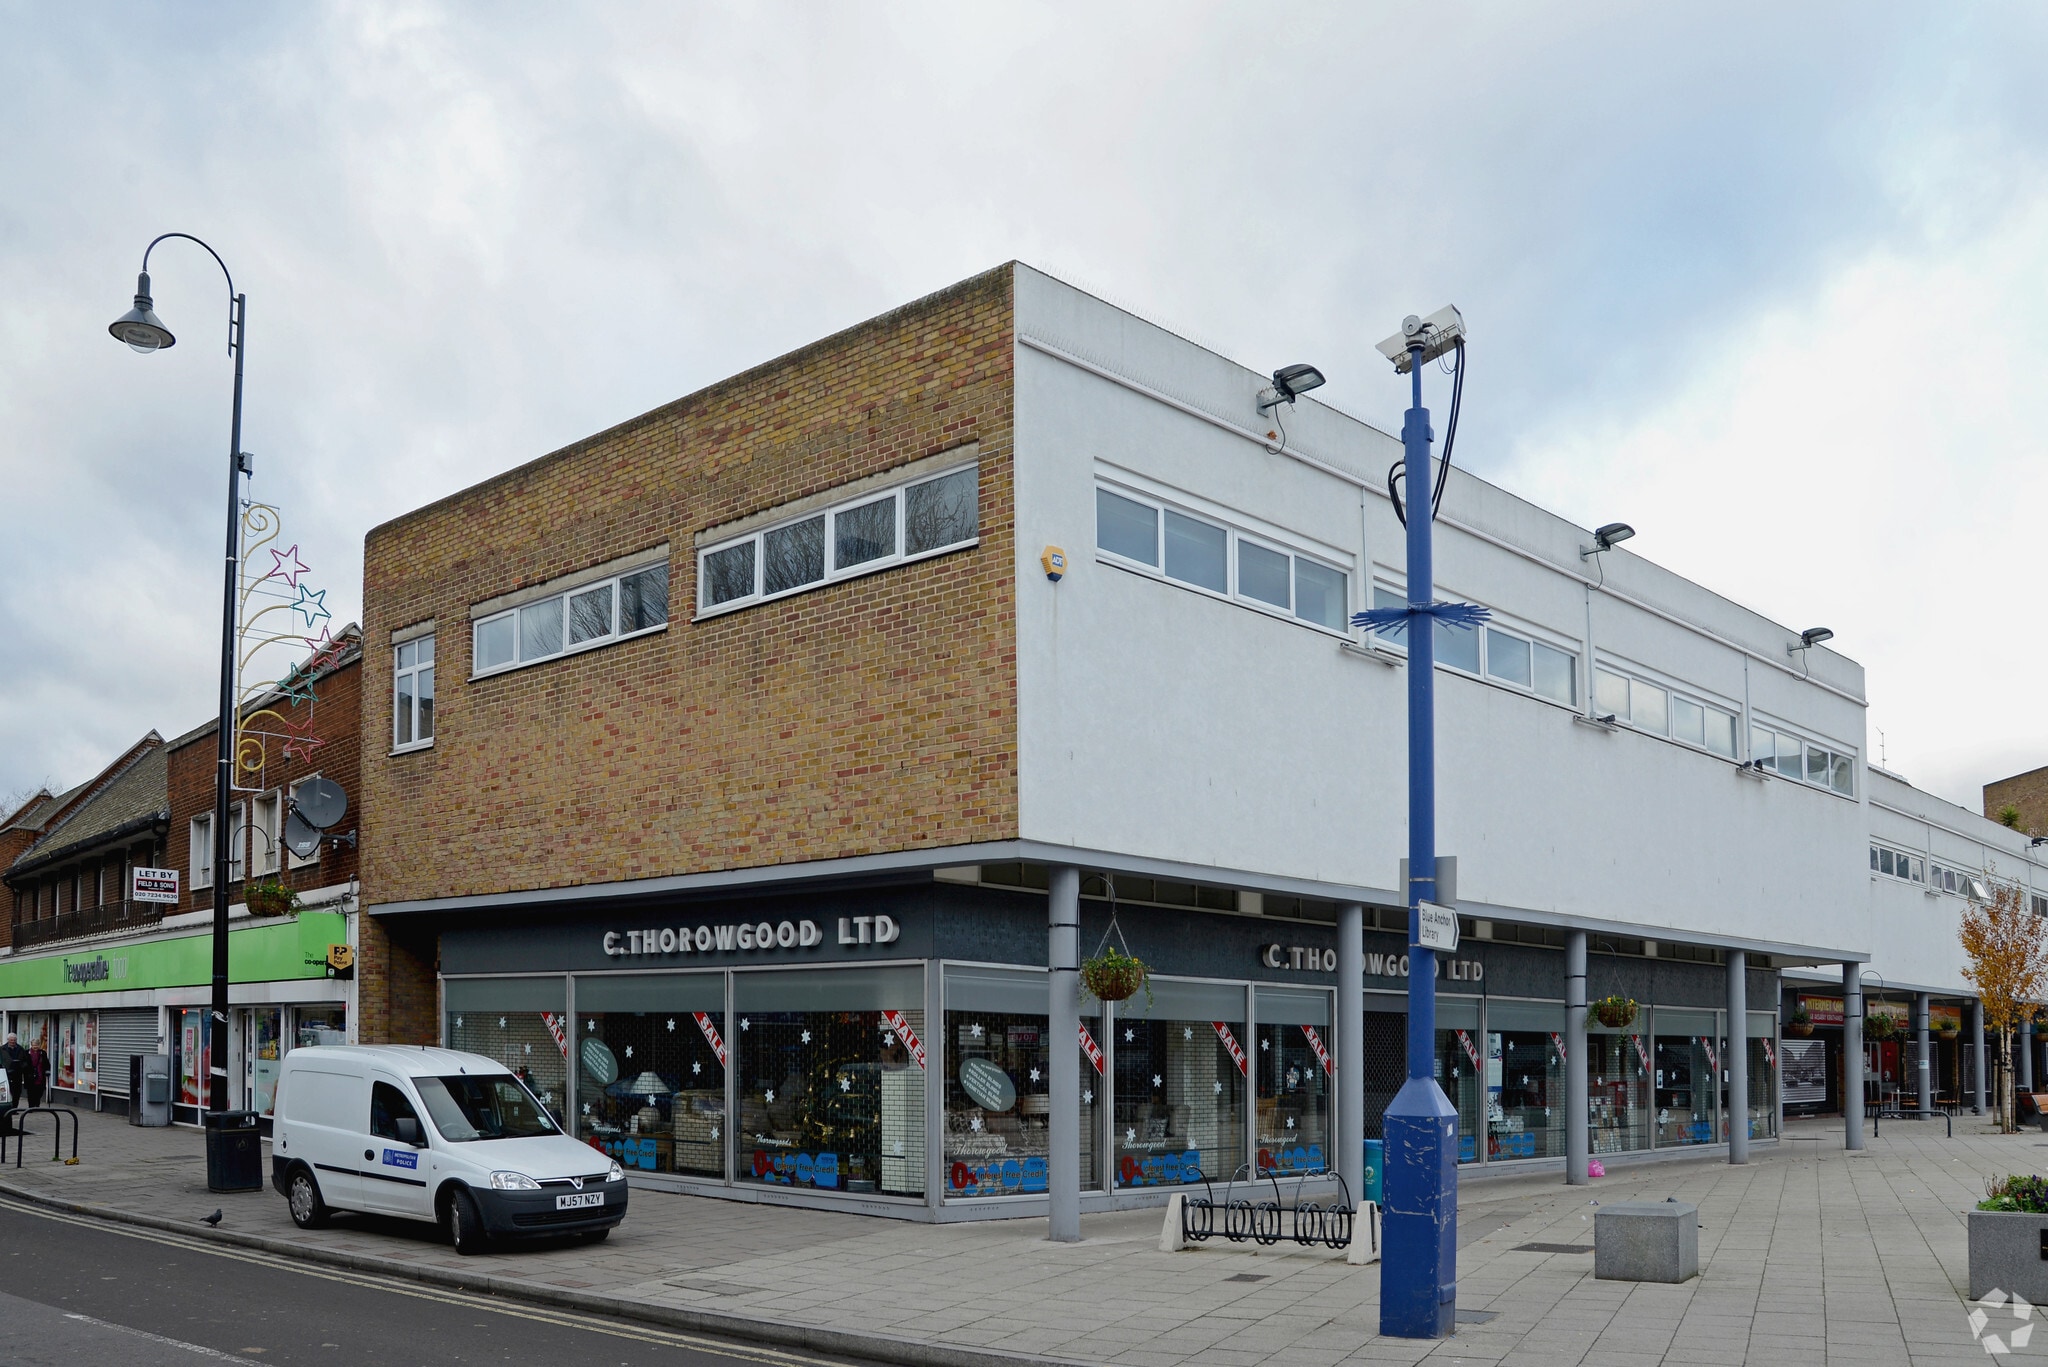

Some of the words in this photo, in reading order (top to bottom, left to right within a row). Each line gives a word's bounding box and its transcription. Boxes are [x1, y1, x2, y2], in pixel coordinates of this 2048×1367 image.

[139, 870, 157, 878] LET
[1422, 908, 1433, 923] Blue
[1434, 911, 1451, 927] Anchor
[838, 915, 899, 945] LTD
[1422, 925, 1439, 943] Library
[113, 951, 128, 979] food
[1447, 960, 1484, 981] LTD
[546, 1014, 568, 1053] SALE
[700, 1016, 726, 1060] SALE
[1079, 1027, 1101, 1064] ALE
[1219, 1026, 1243, 1066] SALE
[1306, 1027, 1329, 1067] SALE
[1460, 1031, 1480, 1066] SALE
[1554, 1034, 1566, 1063] SAL
[1634, 1036, 1649, 1067] SALE
[1704, 1038, 1717, 1066] SALE
[1122, 1138, 1166, 1152] Thorowgood
[1260, 1133, 1298, 1148] Thorowgood
[639, 1149, 655, 1158] Credit
[954, 1143, 1007, 1159] Thorowgood
[396, 1158, 413, 1167] POLICE
[776, 1161, 798, 1171] Interest
[799, 1163, 813, 1172] Free
[814, 1164, 835, 1174] Credit
[1165, 1163, 1179, 1171] Free
[978, 1171, 1002, 1180] Interest
[1005, 1170, 1021, 1179] Free
[1022, 1169, 1044, 1179] Credit
[560, 1195, 583, 1208] MJ57
[584, 1193, 601, 1206] NZY
